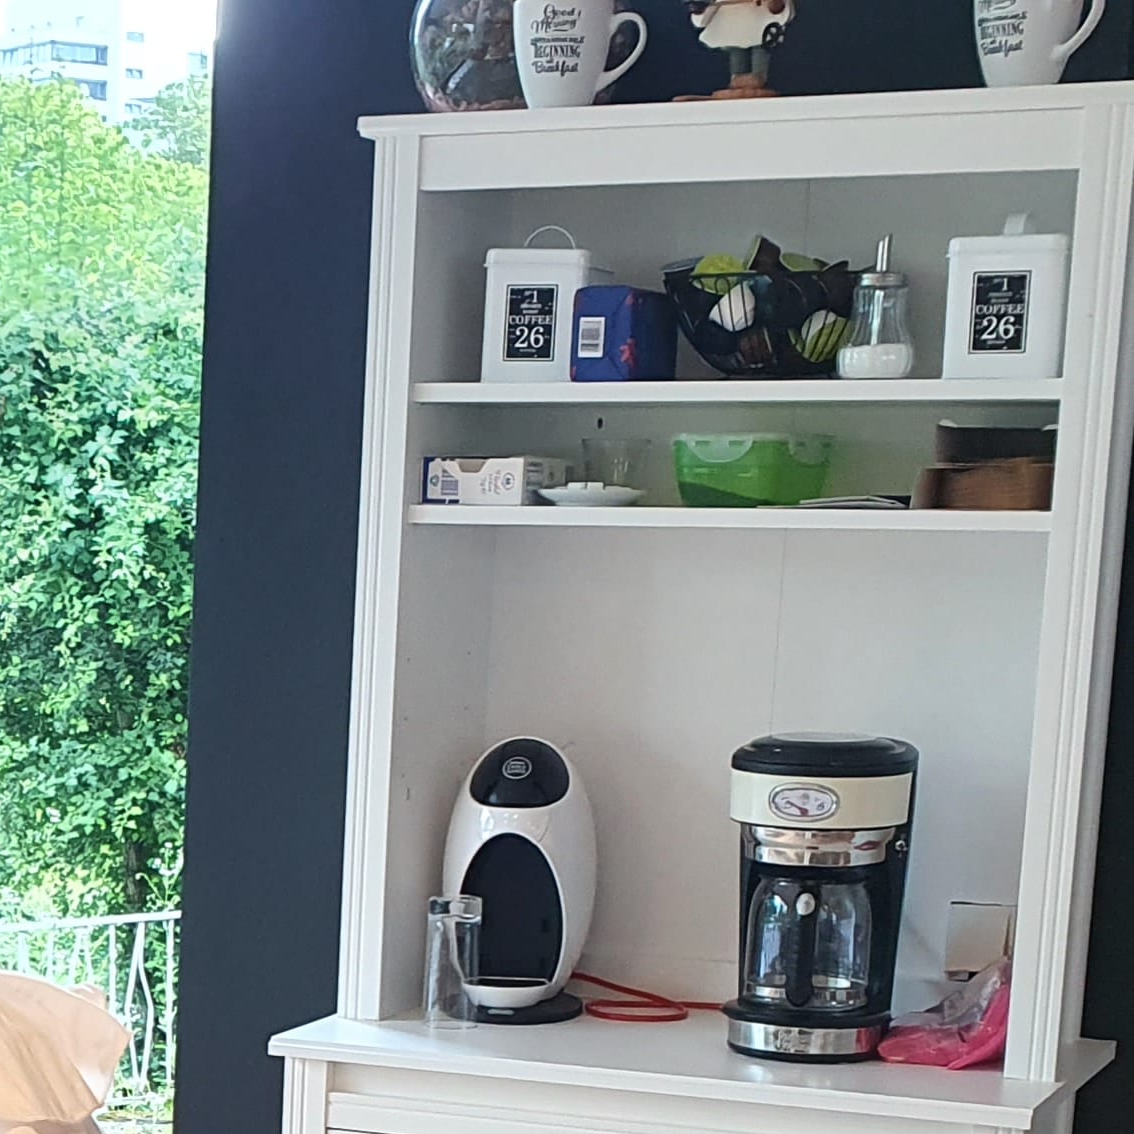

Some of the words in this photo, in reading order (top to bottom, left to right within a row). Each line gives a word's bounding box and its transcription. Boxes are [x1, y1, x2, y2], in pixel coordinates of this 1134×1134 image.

[976, 303, 1025, 315] COFFEE
[509, 314, 553, 325] COFFEE
[980, 315, 1016, 340] 26
[514, 326, 545, 348] 26
